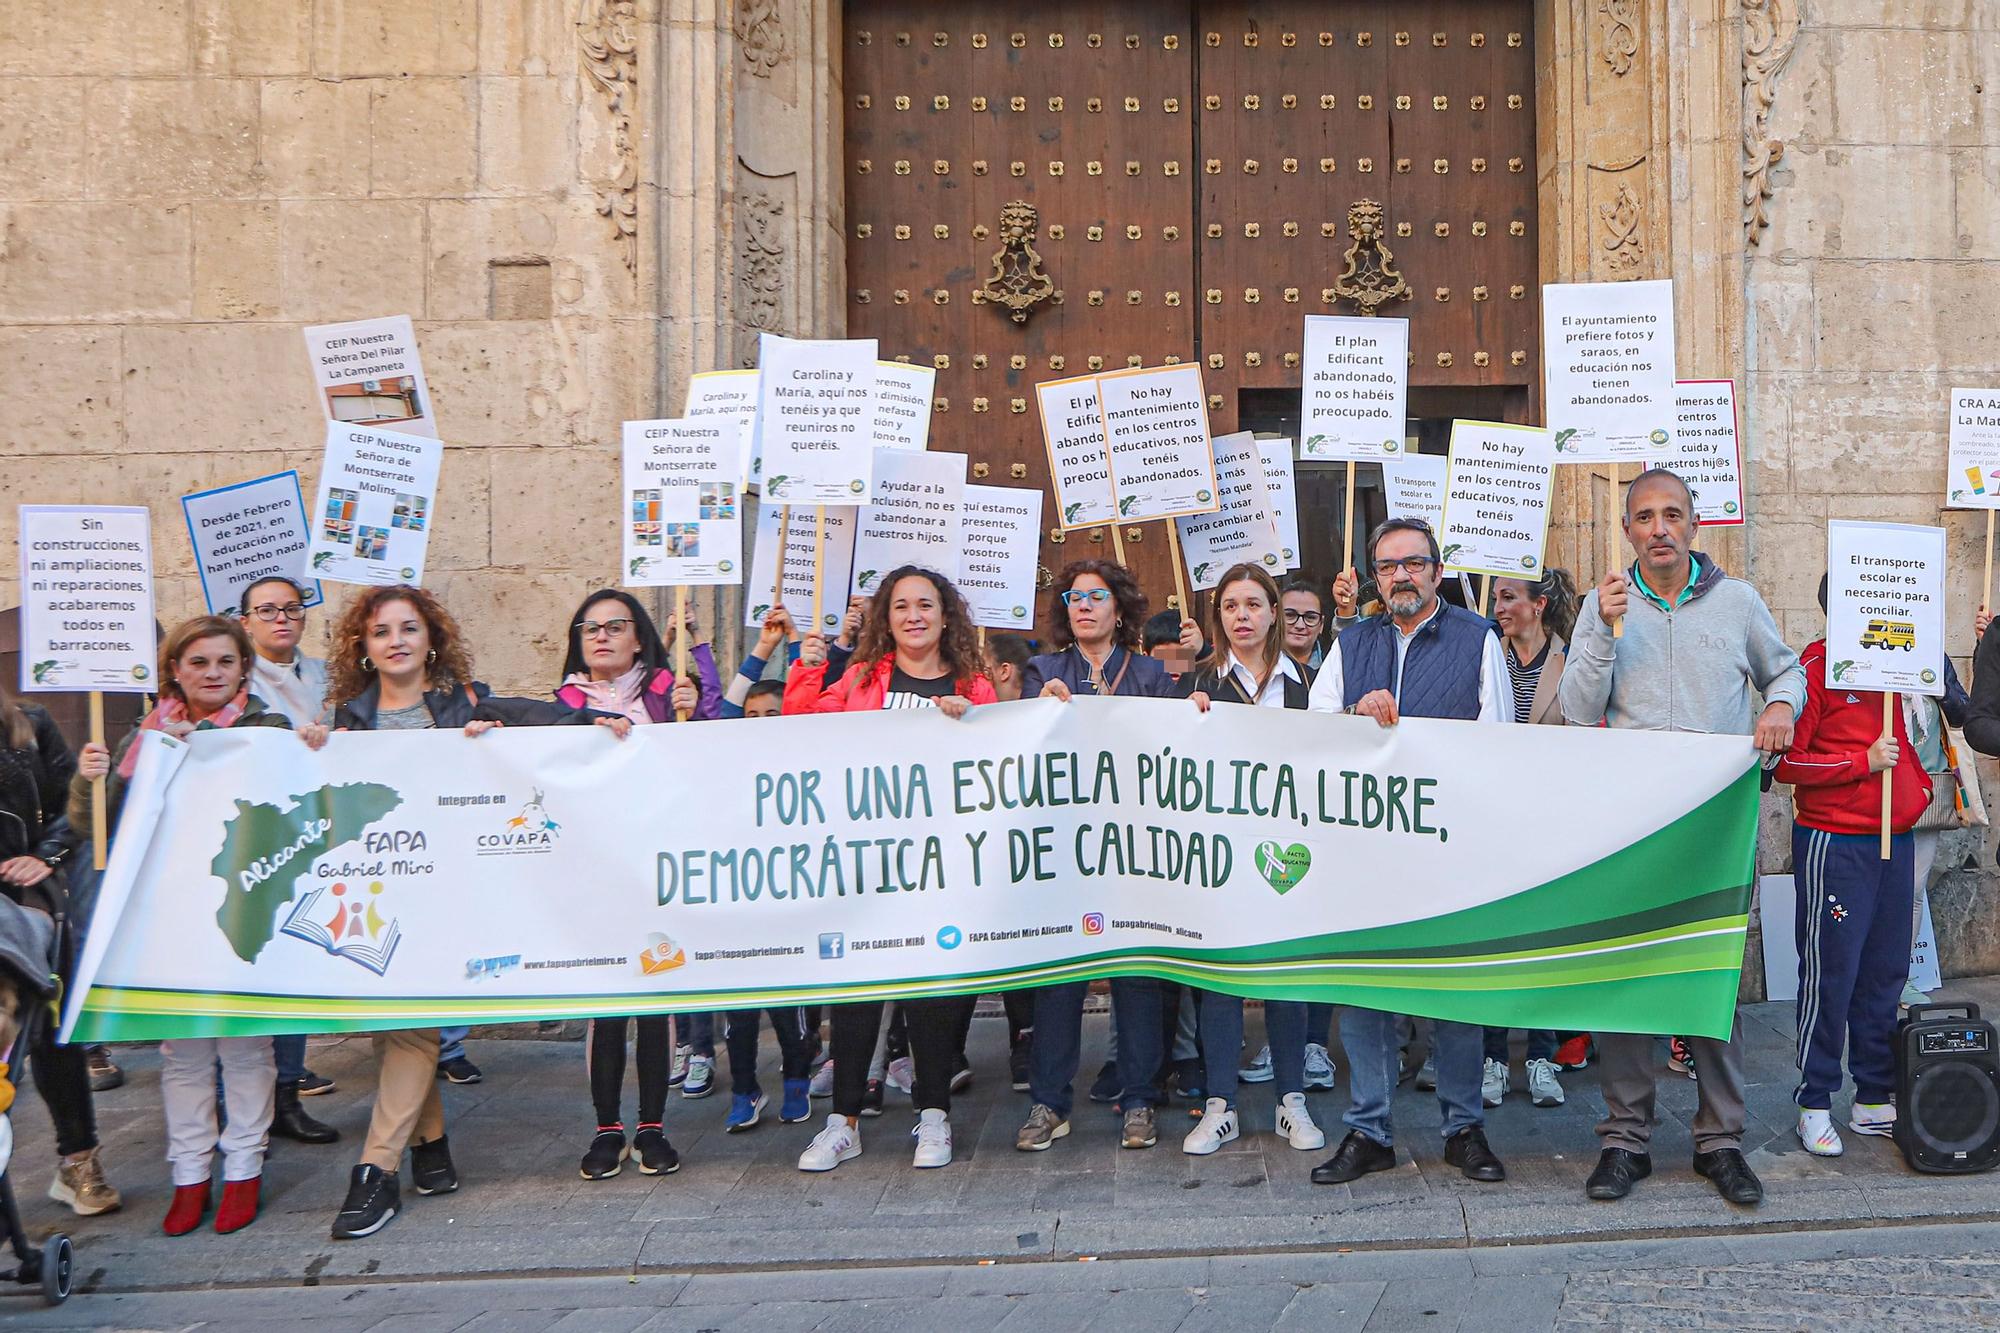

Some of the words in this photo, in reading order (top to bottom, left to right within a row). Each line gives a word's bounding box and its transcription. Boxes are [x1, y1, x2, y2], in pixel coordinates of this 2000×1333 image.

[1562, 317, 1571, 325] El
[1575, 314, 1657, 327] ayuntamiento
[326, 338, 348, 349] CEIP
[351, 333, 395, 346] Nuestra
[1335, 336, 1345, 346] El
[1350, 336, 1376, 348] plan
[1566, 332, 1612, 343] prefiere
[1615, 330, 1644, 340] fotos
[321, 350, 358, 365] Señora
[361, 350, 378, 360] Del
[382, 346, 405, 356] Pilar
[1581, 349, 1622, 358] saraos,
[1625, 347, 1639, 355] en
[1328, 354, 1384, 365] Edificant
[328, 370, 342, 379] La
[344, 361, 405, 377] Campaneta
[1569, 362, 1628, 373] educación
[1631, 361, 1652, 371] nos
[792, 370, 844, 380] Carolina
[1314, 371, 1396, 384] abandonado,
[1592, 379, 1630, 388] tienen
[775, 387, 815, 398] María,
[818, 388, 845, 400] aquí
[847, 388, 867, 397] nos
[1130, 390, 1148, 400] No
[1151, 387, 1172, 398] hay
[1315, 390, 1331, 398] no
[1353, 389, 1394, 401] habéis
[1571, 394, 1652, 405] abandonados.
[781, 403, 820, 415] tenéis
[822, 406, 837, 417] ya
[839, 406, 861, 417] que
[1959, 399, 1984, 408] CRA
[1108, 401, 1200, 420] mantenimiento
[1313, 408, 1392, 419] preocupado.
[1958, 416, 1972, 424] La
[645, 429, 669, 438] CEIP
[672, 428, 720, 437] Nuestra
[786, 422, 838, 433] reuniros
[841, 424, 855, 433] no
[1115, 428, 1129, 436] en
[1133, 424, 1150, 433] los
[1153, 418, 1197, 430] centros
[349, 433, 374, 443] CEIP
[377, 438, 422, 454] Nuestra
[653, 444, 693, 455] Señora
[696, 444, 711, 453] de
[791, 438, 840, 452] queréis.
[1112, 439, 1180, 453] educativos,
[1183, 433, 1204, 444] nos
[1482, 441, 1499, 451] No
[1502, 442, 1524, 456] hay
[355, 450, 395, 464] Señora
[398, 456, 412, 467] de
[1142, 453, 1179, 466] tenéis
[1654, 459, 1700, 469] nuestros
[1702, 458, 1730, 468] hij@s
[644, 460, 717, 471] Montserrate
[1454, 458, 1548, 474] mantenimiento
[345, 464, 415, 483] Montserrate
[1120, 468, 1203, 486] abandonados.
[1701, 474, 1710, 482] la
[1712, 474, 1737, 482] vida.
[660, 478, 699, 486] Molins
[881, 481, 921, 493] Ayudar
[935, 485, 944, 494] la
[1458, 474, 1472, 483] en
[1475, 474, 1492, 484] los
[1495, 478, 1541, 490] centros
[359, 482, 397, 496] Molins
[1451, 490, 1519, 506] educativos,
[1522, 498, 1544, 508] nos
[201, 511, 241, 528] Desde
[244, 499, 291, 516] Febrero
[982, 504, 1028, 515] estamos
[1476, 509, 1513, 521] tenéis
[81, 519, 103, 530] Sin
[874, 513, 936, 525] abandonar
[962, 518, 1018, 531] presentes,
[1187, 522, 1214, 536] para
[1212, 513, 1253, 528] cambiar
[1255, 511, 1265, 520] el
[215, 531, 231, 540] de
[270, 516, 285, 526] en
[1449, 524, 1534, 541] abandonados.
[212, 534, 276, 556] educación
[280, 529, 294, 539] no
[864, 529, 914, 540] nuestros
[917, 532, 947, 544] hijos.
[968, 534, 1007, 544] porque
[1209, 532, 1248, 544] mundo.
[33, 540, 144, 552] construcciones,
[207, 561, 232, 574] han
[235, 550, 272, 566] hecho
[276, 541, 305, 554] nada
[962, 548, 1010, 559] vosotros
[31, 559, 46, 570] ni
[50, 559, 146, 573] ampliaciones,
[969, 563, 1001, 574] estáis
[1850, 555, 1860, 564] El
[1864, 556, 1925, 569] transporte
[228, 564, 284, 583] ninguno.
[1859, 573, 1901, 584] escolar
[1905, 577, 1917, 585] es
[32, 580, 47, 590] ni
[52, 580, 146, 593] reparaciones,
[1845, 589, 1901, 600] necesario
[1905, 592, 1929, 602] para
[48, 600, 135, 611] acabaremos
[1860, 605, 1913, 617] conciliar.
[63, 620, 105, 630] todos
[109, 622, 125, 630] en
[49, 640, 134, 651] barracones.
[438, 794, 491, 806] Integrada
[493, 794, 506, 804] en
[756, 770, 825, 827] POR
[846, 763, 933, 821] UNA
[952, 750, 1120, 815] ESCUELA
[1138, 746, 1309, 827] PÚBLICA,
[1318, 768, 1448, 843] LIBRE,
[364, 830, 427, 854] FAPA
[477, 832, 551, 848] COVAPA
[240, 817, 331, 892] Alicante
[317, 862, 387, 879] Gabriel
[391, 861, 434, 876] Miró
[657, 834, 945, 906] DEMOCRÁTICA
[965, 830, 987, 886] Y
[1008, 826, 1057, 884] DE
[1075, 822, 1233, 888] CALIDAD
[969, 933, 989, 942] FAPA
[991, 930, 1020, 941] Gabriel
[1022, 928, 1040, 938] Miró
[1041, 925, 1073, 936] Alicante
[851, 941, 870, 950] FAPA
[872, 938, 903, 949] GABRIEL
[905, 936, 925, 946] MIRÓ
